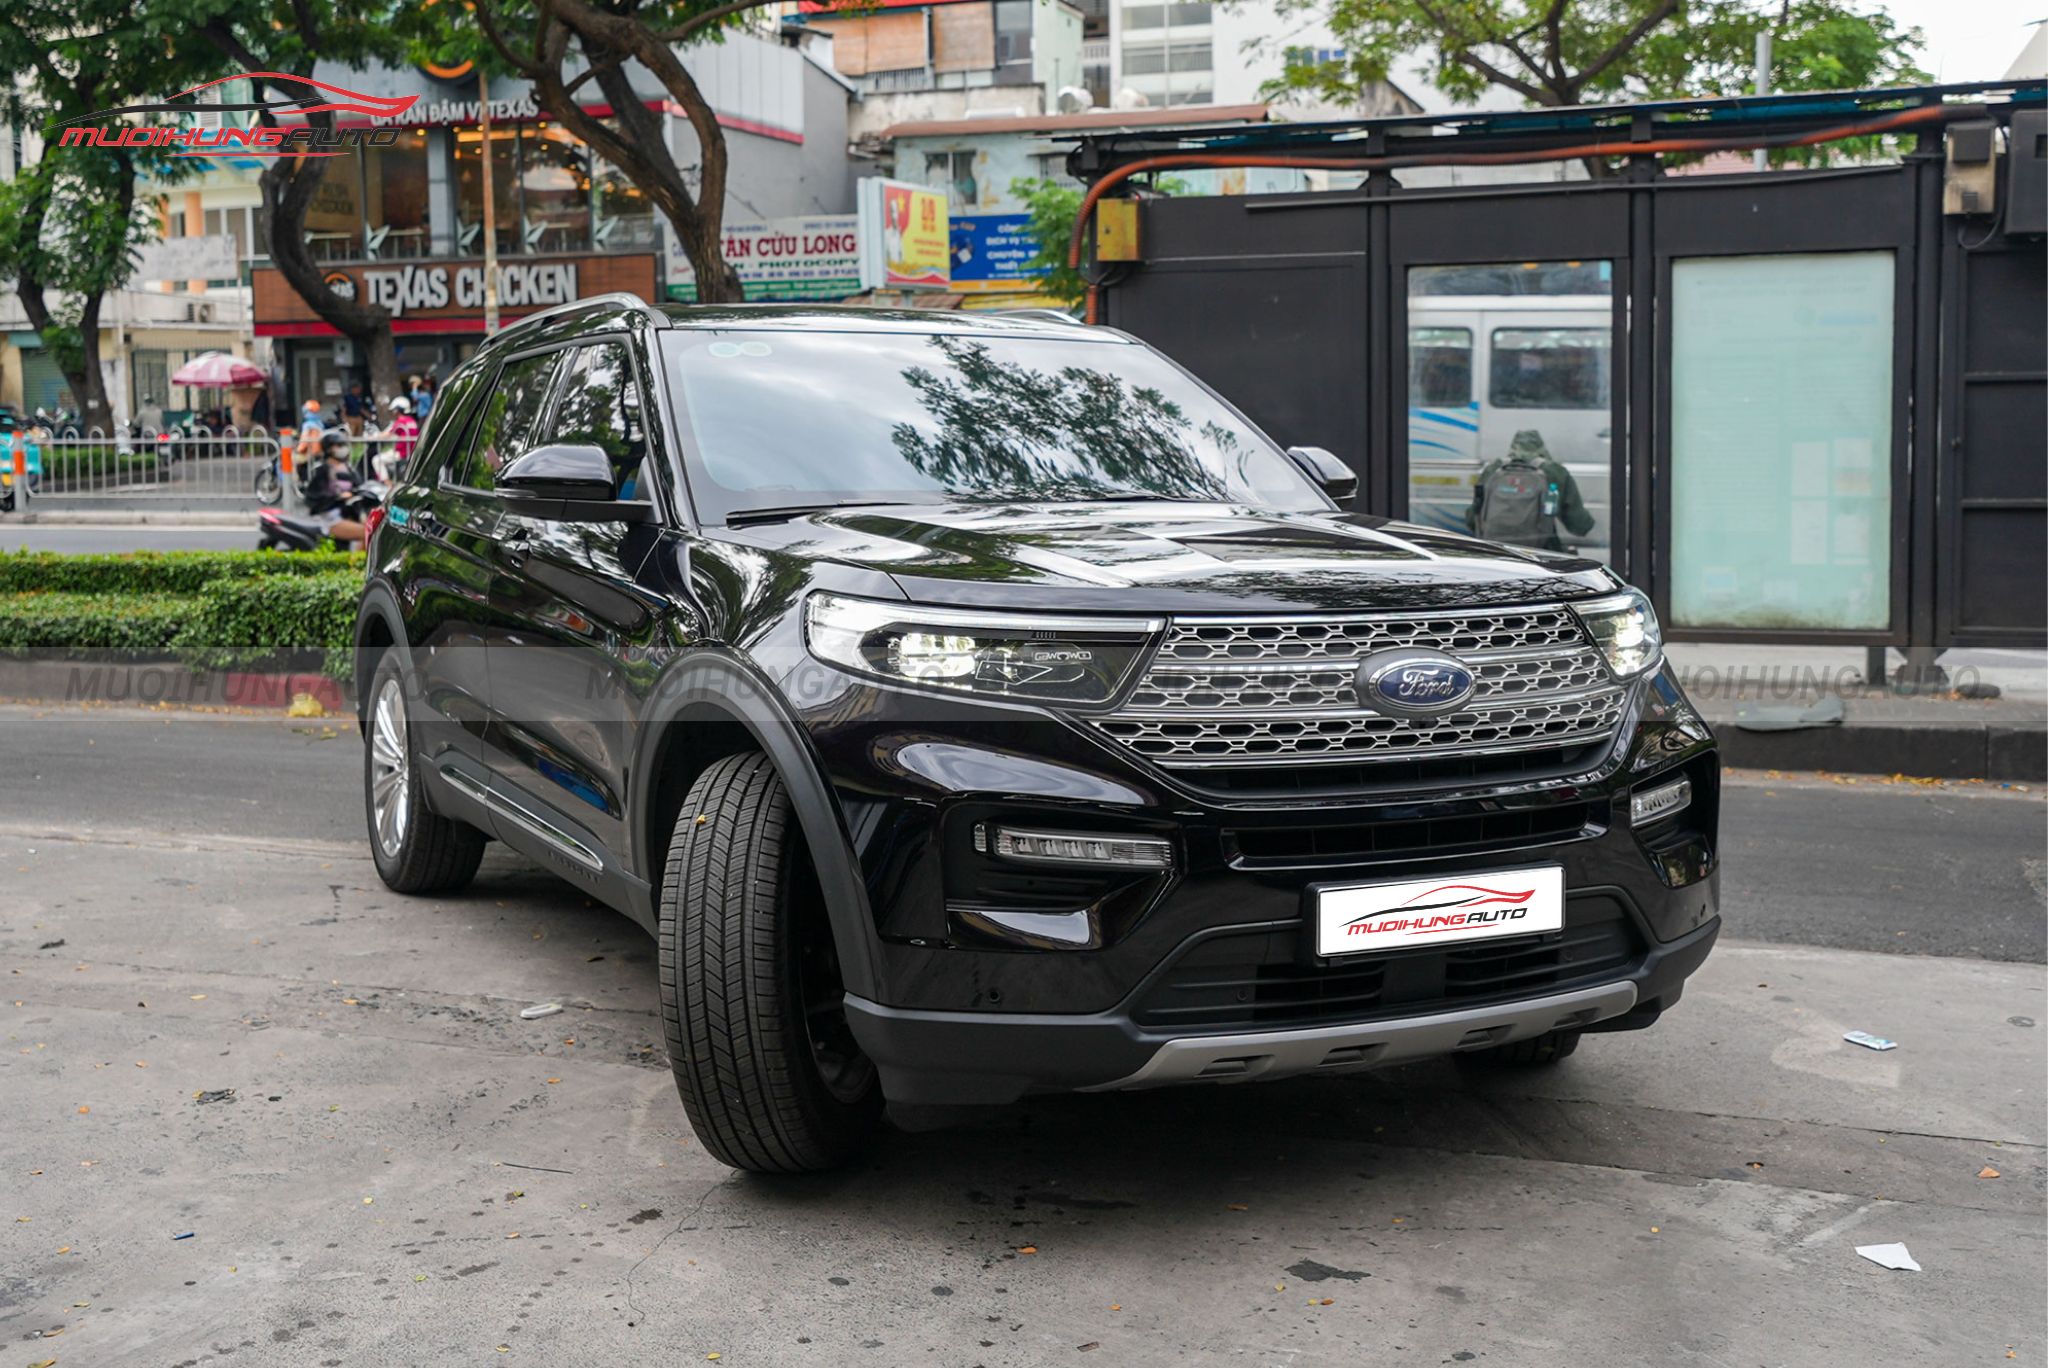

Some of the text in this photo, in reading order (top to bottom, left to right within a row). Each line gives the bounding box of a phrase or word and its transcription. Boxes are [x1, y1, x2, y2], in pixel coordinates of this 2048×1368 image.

[721, 235, 751, 259] ÂN
[804, 234, 856, 255] LONG
[758, 258, 859, 269] PHOTOCOPY
[363, 265, 450, 318] TEXAS
[1400, 669, 1454, 697] Ford
